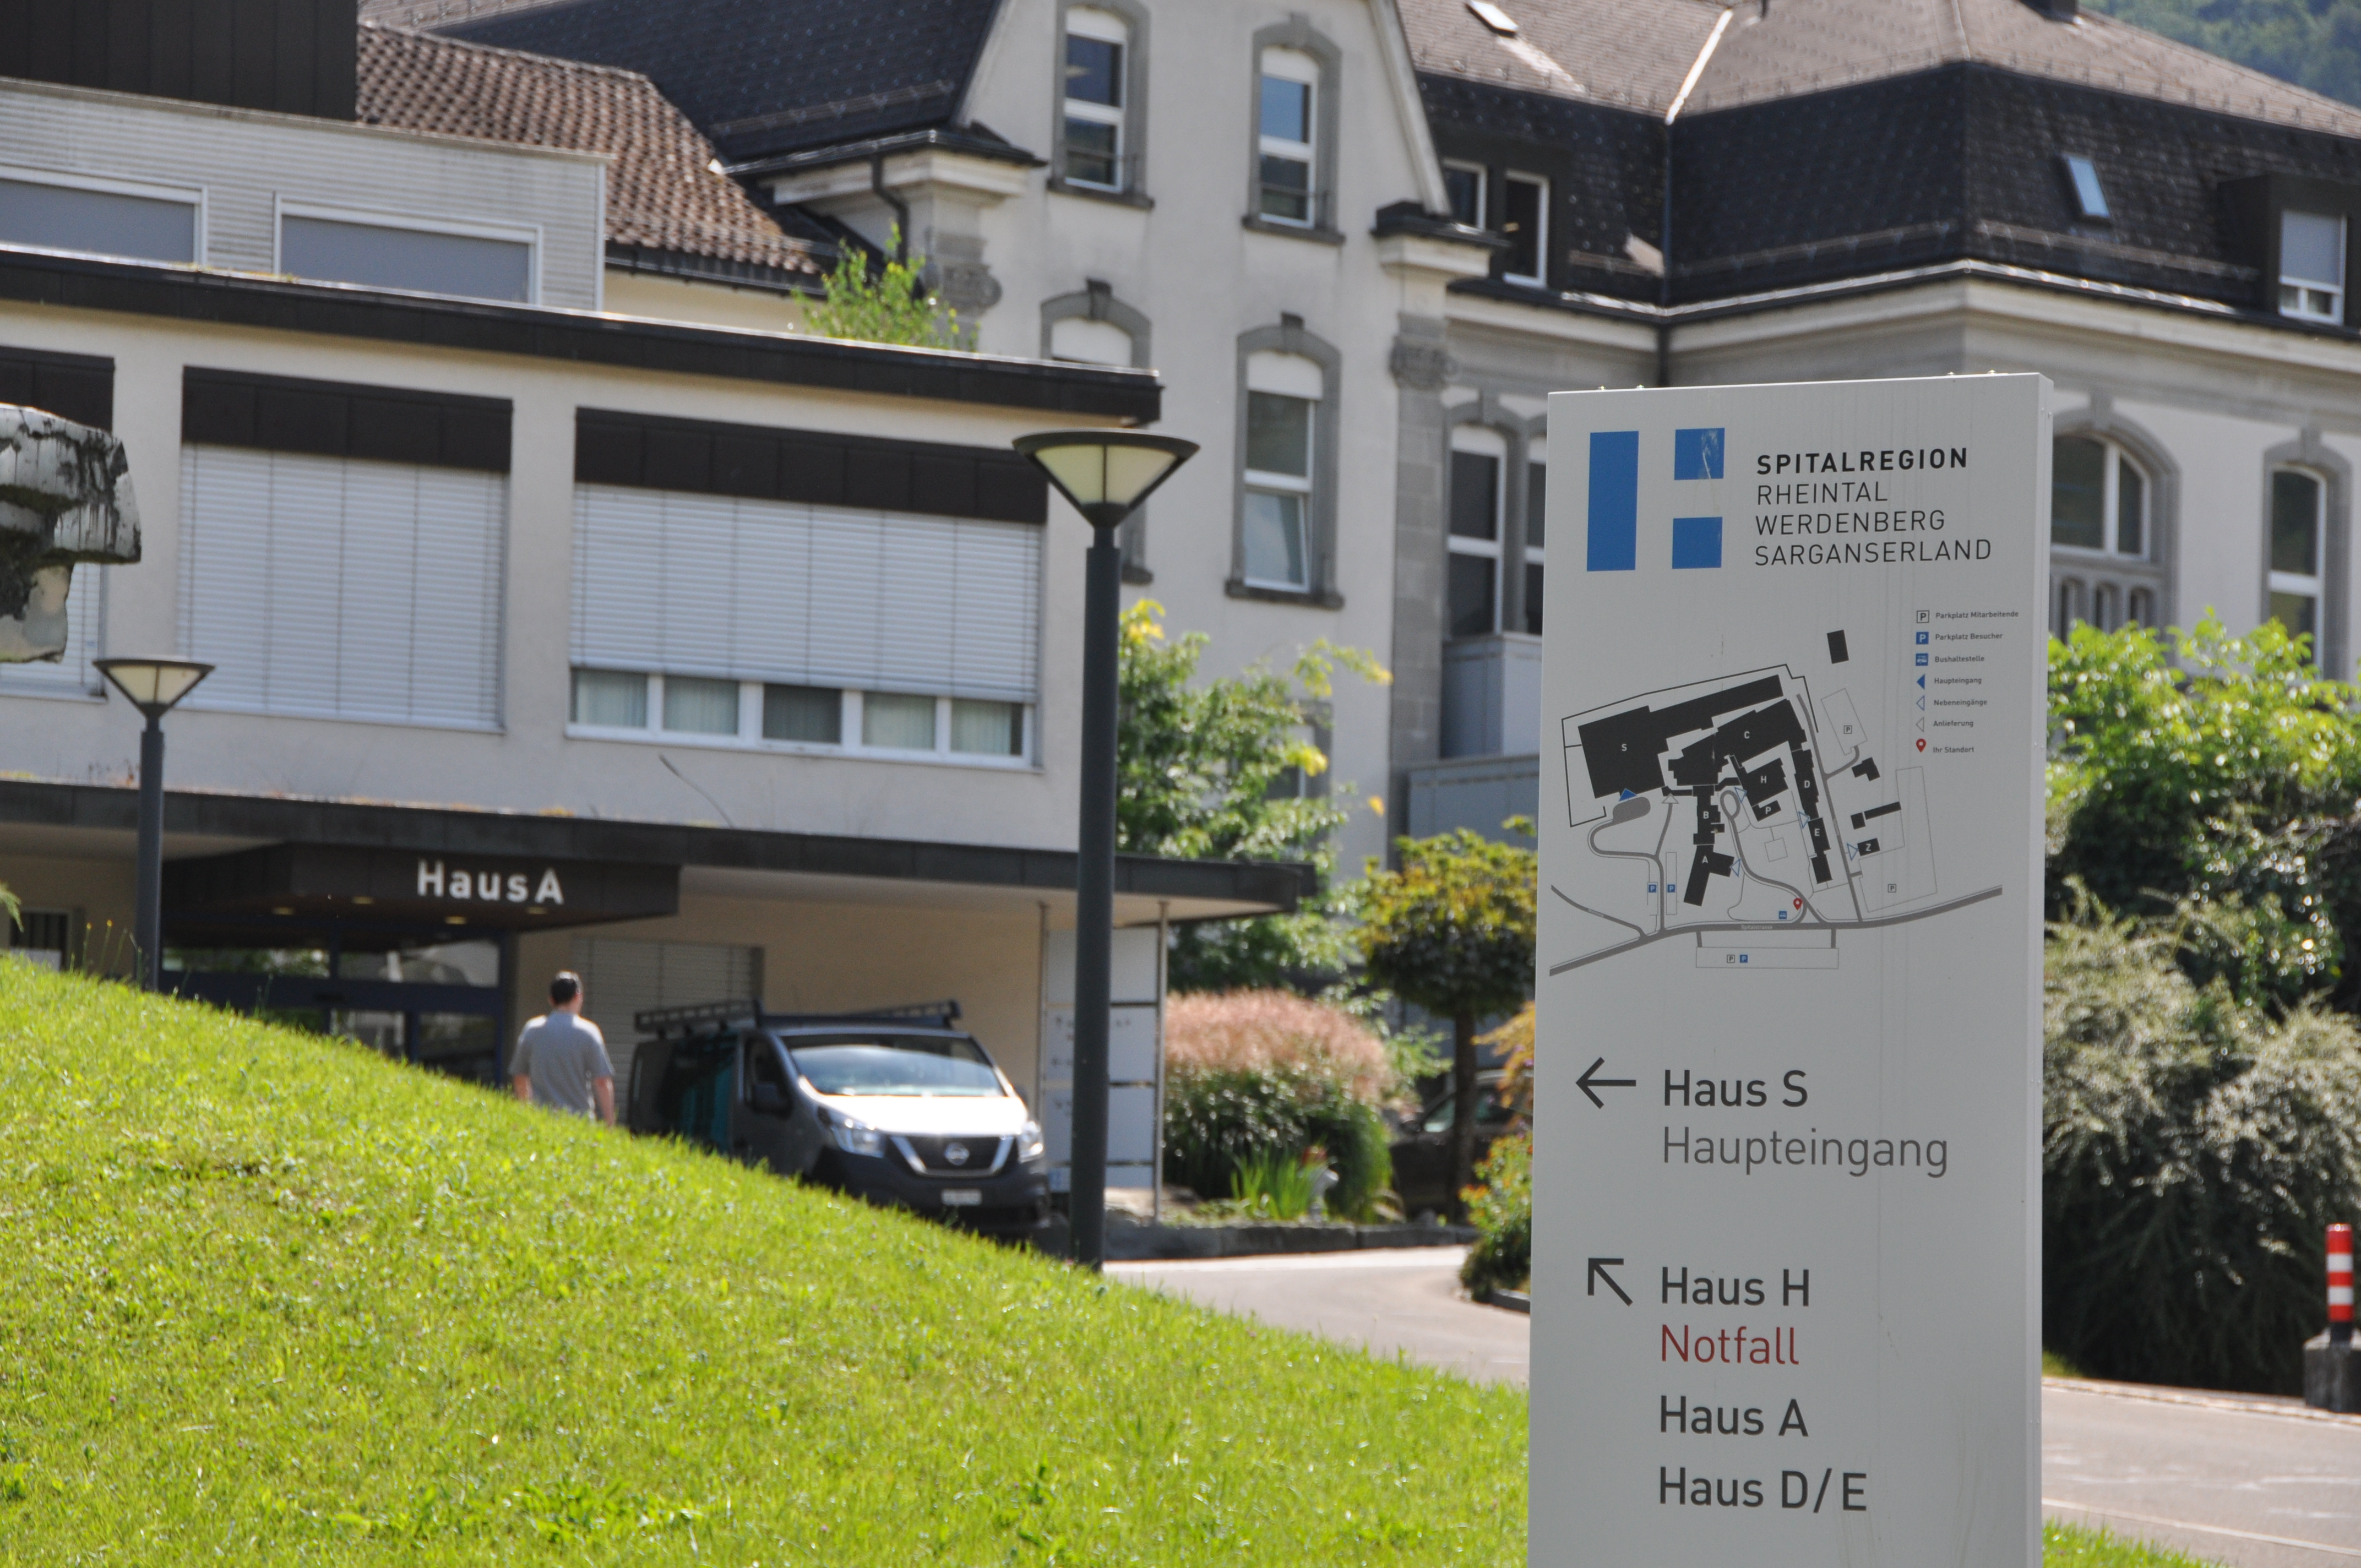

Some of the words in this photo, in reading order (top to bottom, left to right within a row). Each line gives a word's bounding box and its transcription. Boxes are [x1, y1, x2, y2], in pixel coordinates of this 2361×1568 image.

[1757, 448, 1968, 476] SPITALREGION
[1758, 482, 1889, 506] RHEINTAL
[1755, 510, 1945, 536] WERDENBERG
[1755, 540, 1992, 567] SARGANSERLAND
[1920, 613, 1927, 621] P
[1919, 634, 1927, 643] P
[1934, 677, 1982, 685] Haupteingang
[1622, 743, 1628, 752] S
[1744, 731, 1750, 739] C
[1804, 780, 1810, 788] D
[1814, 828, 1820, 836] E
[417, 859, 529, 903] Haus
[535, 867, 564, 905] A
[1664, 1069, 1767, 1108] Haus
[1782, 1070, 1808, 1108] S
[1663, 1126, 1948, 1179] Haupteingang
[1662, 1266, 1766, 1306] Haus
[1783, 1268, 1810, 1307] H
[1661, 1324, 1800, 1366] Notfall
[1661, 1395, 1765, 1436] Haus
[1778, 1398, 1809, 1438] A
[1660, 1466, 1764, 1507] Haus
[1782, 1468, 1867, 1514] D/E
